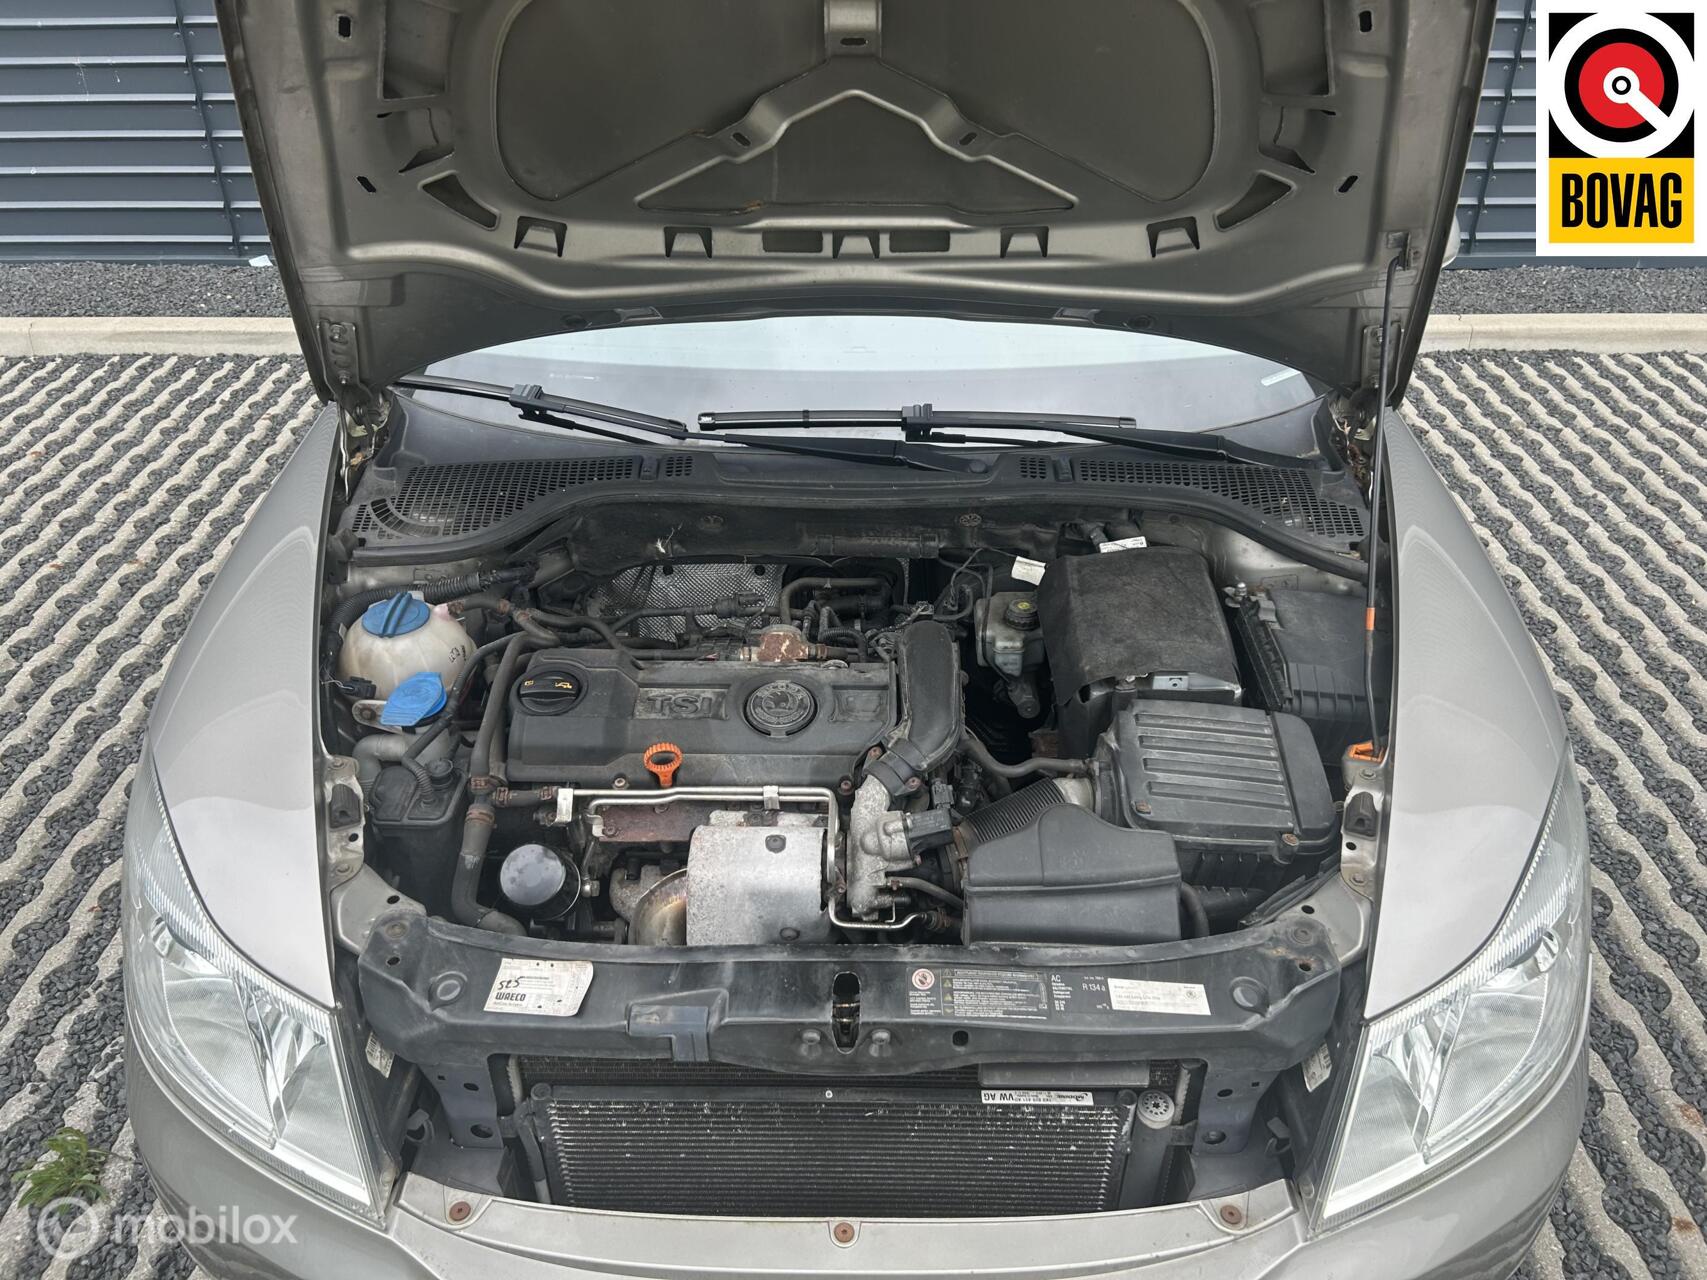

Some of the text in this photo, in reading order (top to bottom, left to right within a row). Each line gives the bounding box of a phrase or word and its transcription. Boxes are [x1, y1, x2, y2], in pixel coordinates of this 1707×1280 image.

[646, 695, 712, 715] TSI
[495, 992, 526, 1001] WAECO
[983, 1092, 996, 1101] AG
[1000, 1092, 1014, 1101] VW
